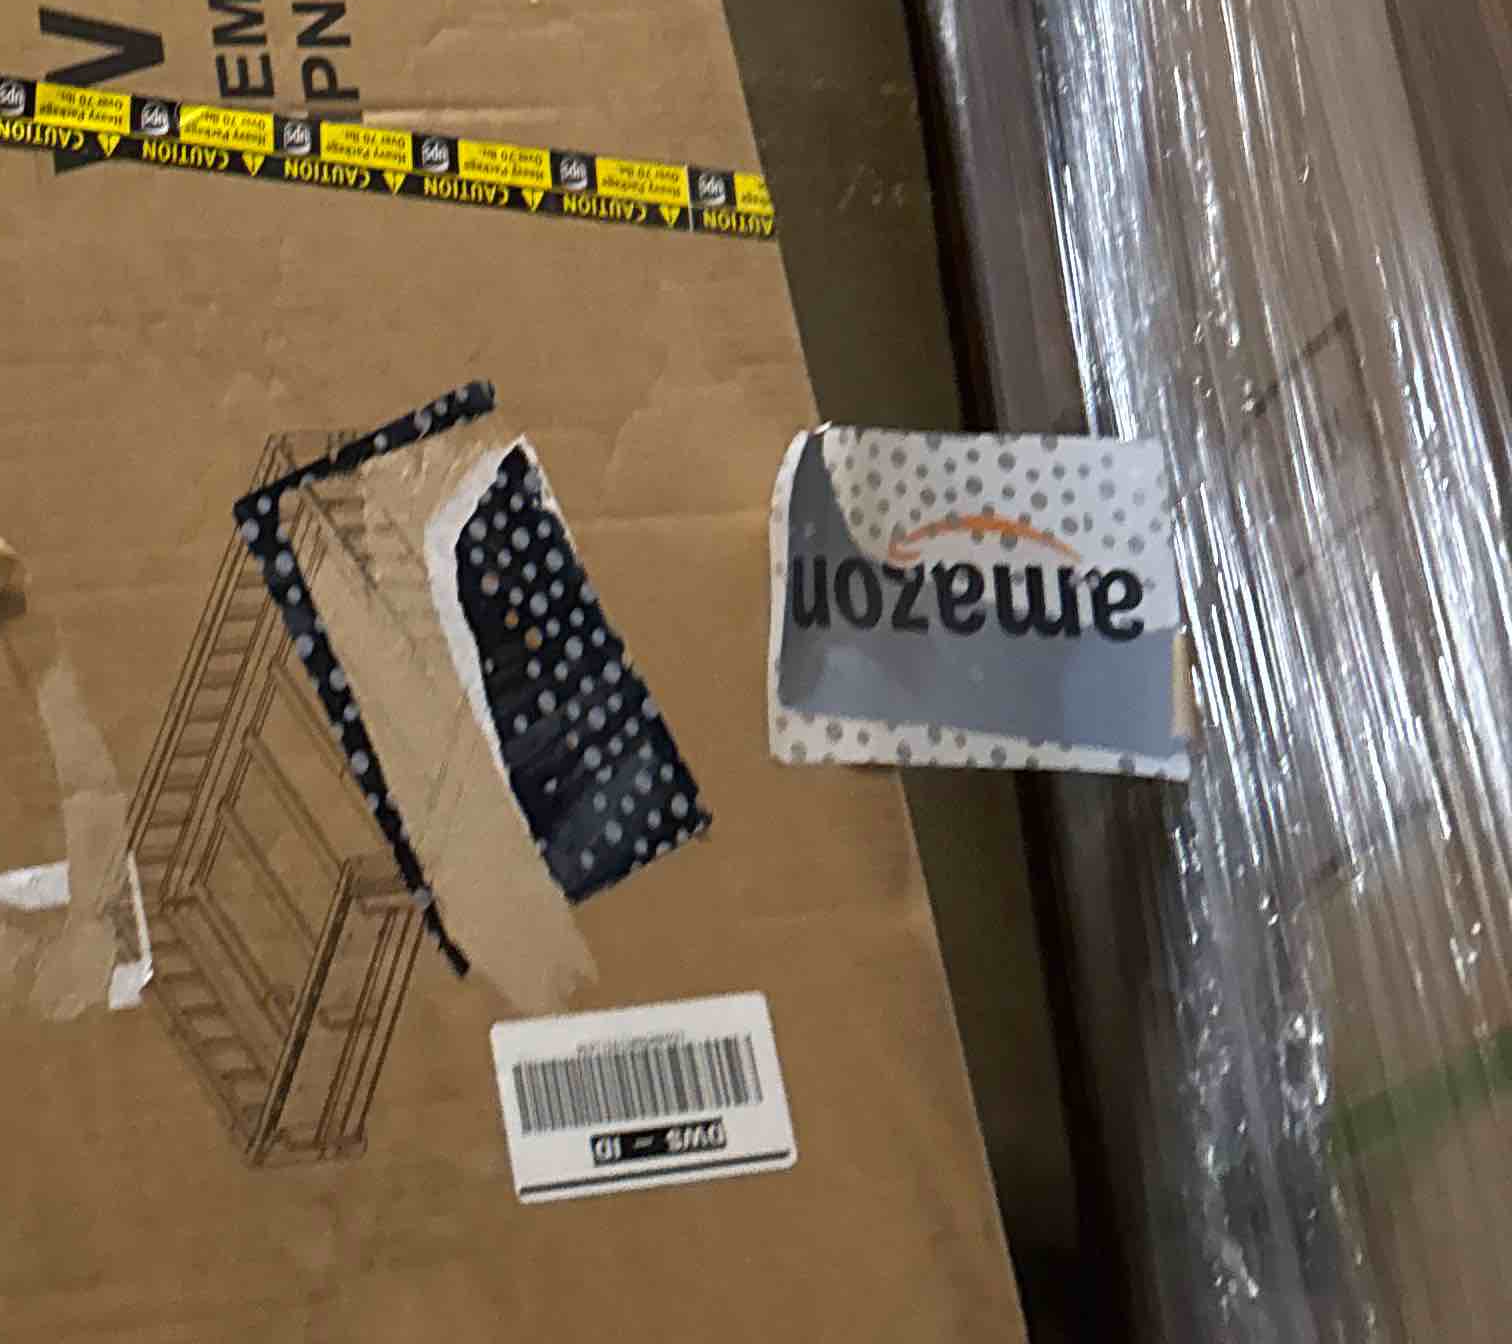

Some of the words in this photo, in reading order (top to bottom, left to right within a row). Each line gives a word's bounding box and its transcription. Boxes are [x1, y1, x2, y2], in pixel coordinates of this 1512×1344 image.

[141, 141, 229, 170] CAUTION
[284, 159, 371, 189] CAUTION
[423, 176, 508, 205] CAUTION
[563, 193, 646, 222] CAUTION
[703, 207, 774, 236] AUTION
[789, 552, 1145, 642] amazon
